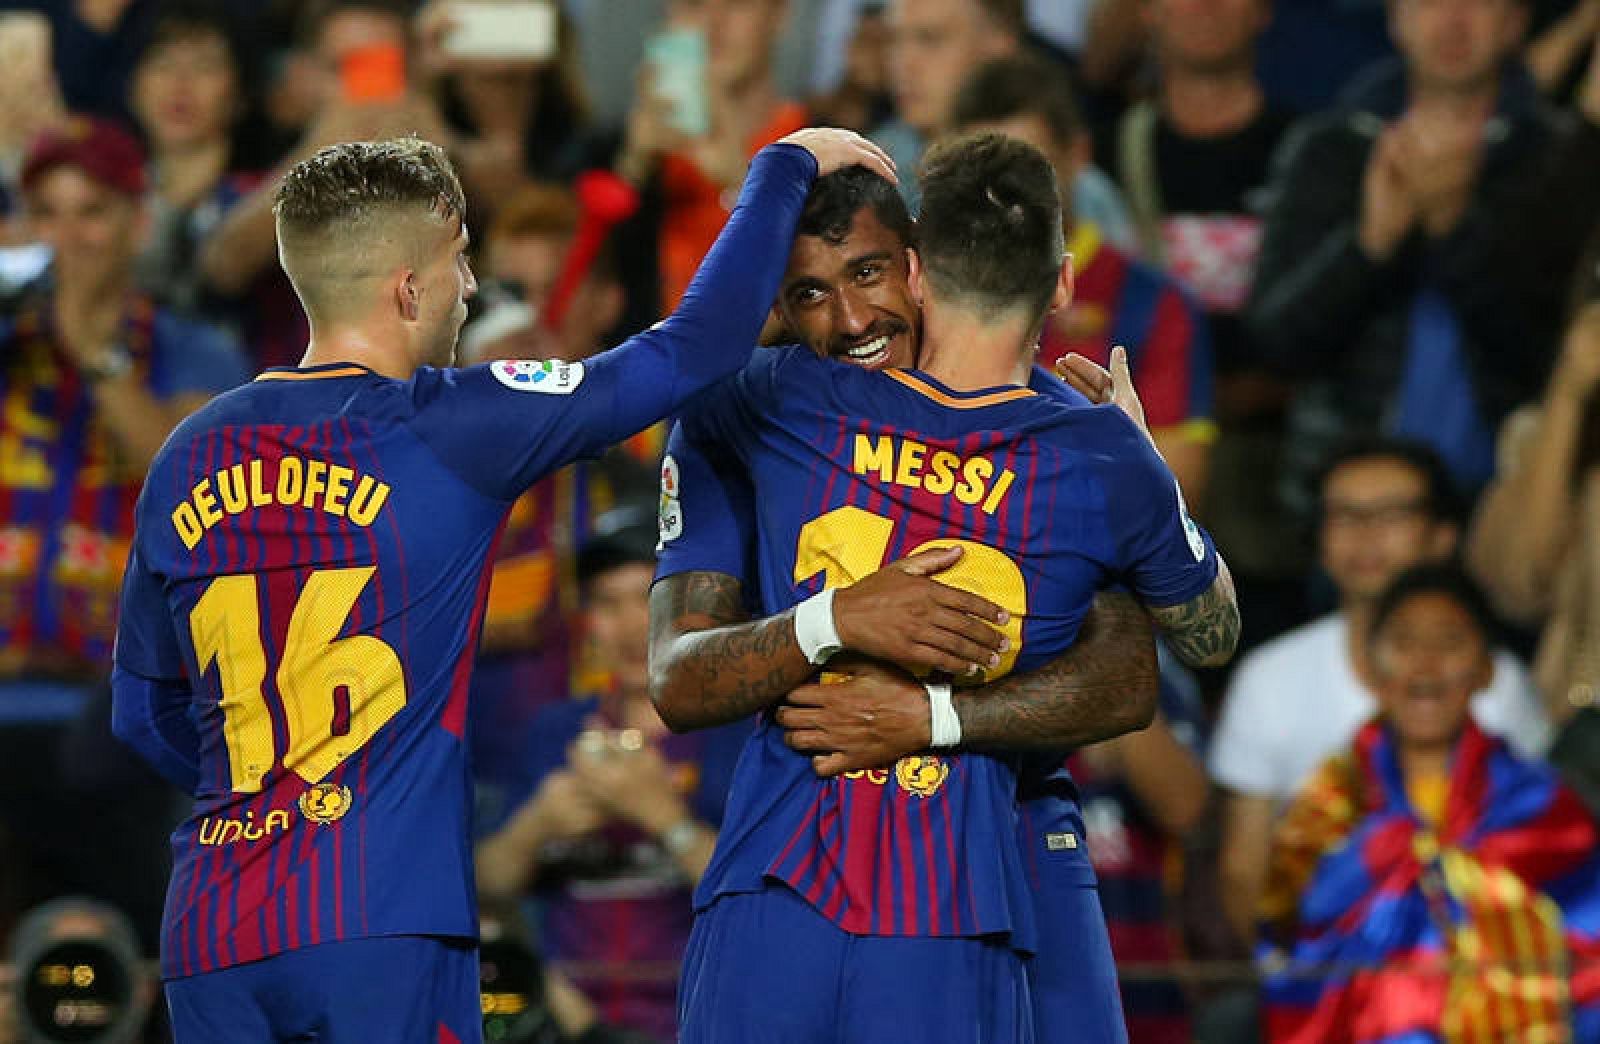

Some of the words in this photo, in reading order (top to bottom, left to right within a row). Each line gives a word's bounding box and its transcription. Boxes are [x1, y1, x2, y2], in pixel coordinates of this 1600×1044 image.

[171, 456, 391, 550] DEULOFEU
[854, 433, 1016, 515] MESSI
[189, 565, 407, 793] 16
